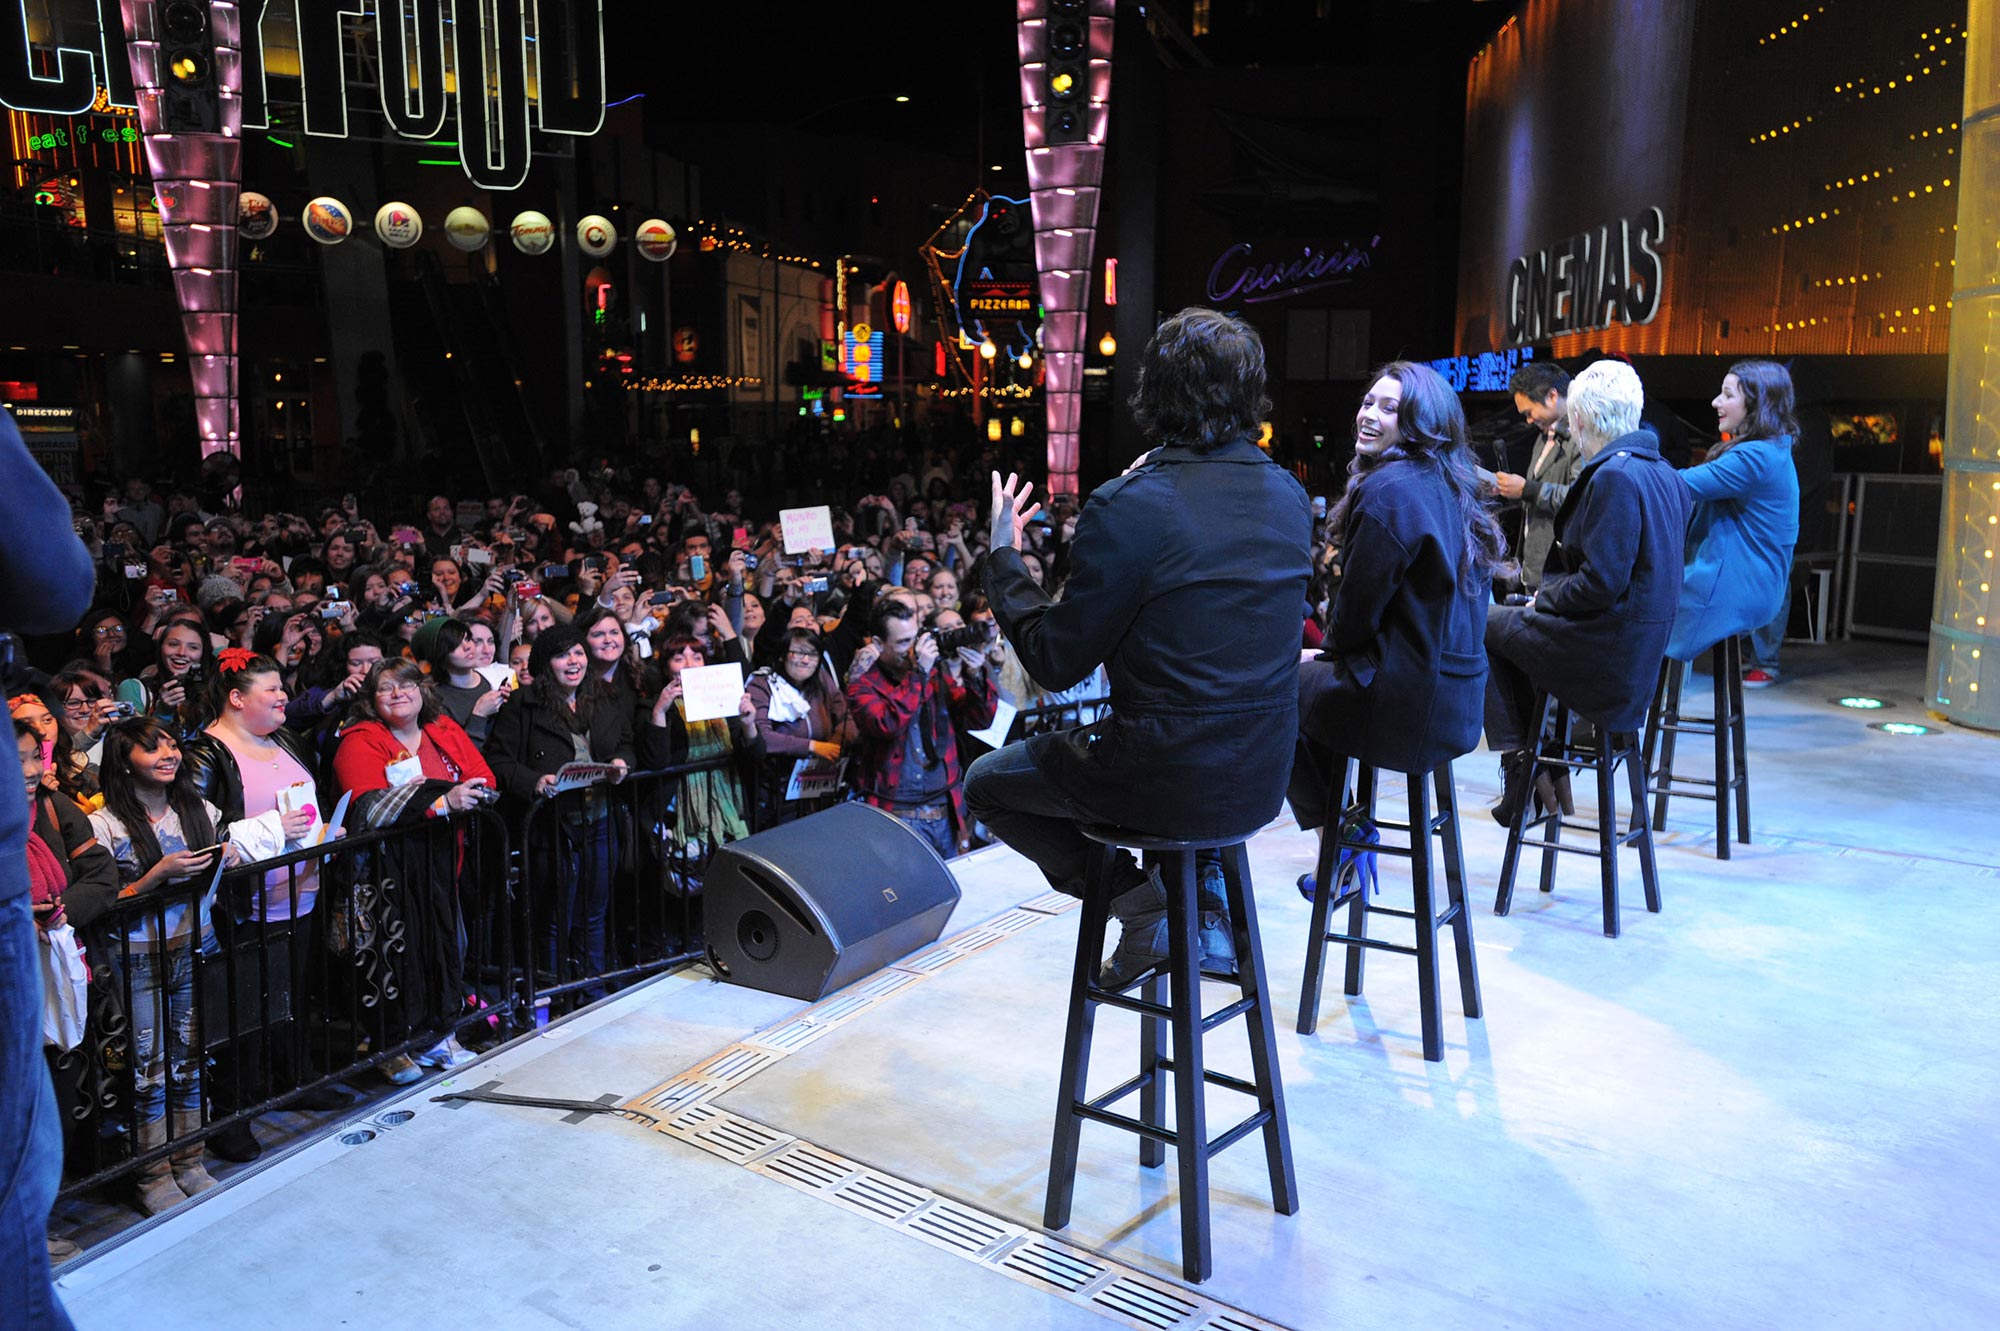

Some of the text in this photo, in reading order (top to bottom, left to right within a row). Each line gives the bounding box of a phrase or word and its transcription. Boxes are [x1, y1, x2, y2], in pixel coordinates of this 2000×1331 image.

[29, 124, 143, 151] eat fes
[1507, 205, 1665, 345] CINEMAS
[970, 298, 1031, 310] PIZZERIA
